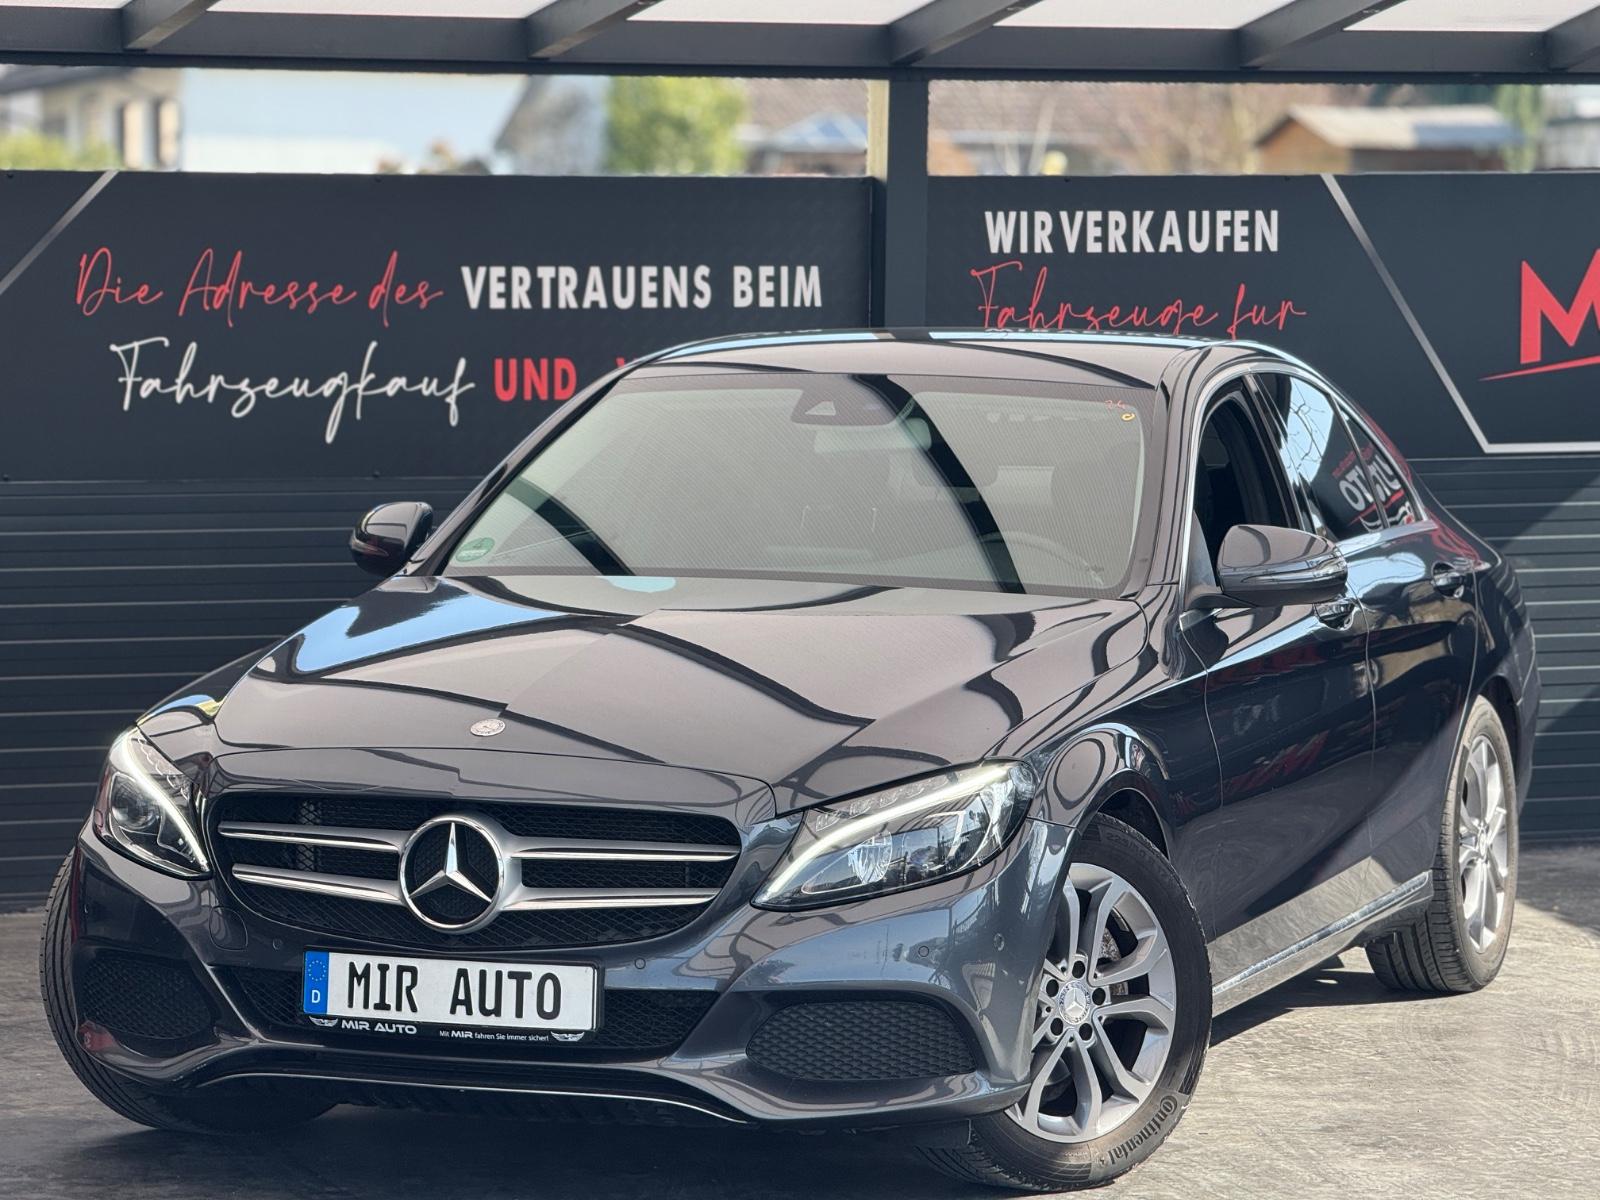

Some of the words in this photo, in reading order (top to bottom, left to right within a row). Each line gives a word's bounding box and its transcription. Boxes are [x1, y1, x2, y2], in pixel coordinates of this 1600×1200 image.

[984, 210, 1055, 254] WIR
[1058, 209, 1280, 254] VERKAUFEN
[75, 246, 164, 315] Die
[178, 248, 358, 328] Adresse
[367, 250, 444, 327] des
[460, 264, 713, 310] VERTRAUENS
[732, 265, 822, 308] BEIM
[970, 260, 1218, 336] Fahrzeuge
[109, 336, 477, 444] Fahrzeugkauf
[493, 356, 577, 402] UND
[311, 989, 321, 1004] D
[347, 960, 419, 1013] MIR
[449, 966, 562, 1021] AUTO
[341, 1019, 371, 1032] MIR
[374, 1022, 418, 1035] AUTO
[451, 1030, 474, 1039] MIR
[474, 1032, 495, 1040] fahren
[1108, 1095, 1178, 1166] Continental
